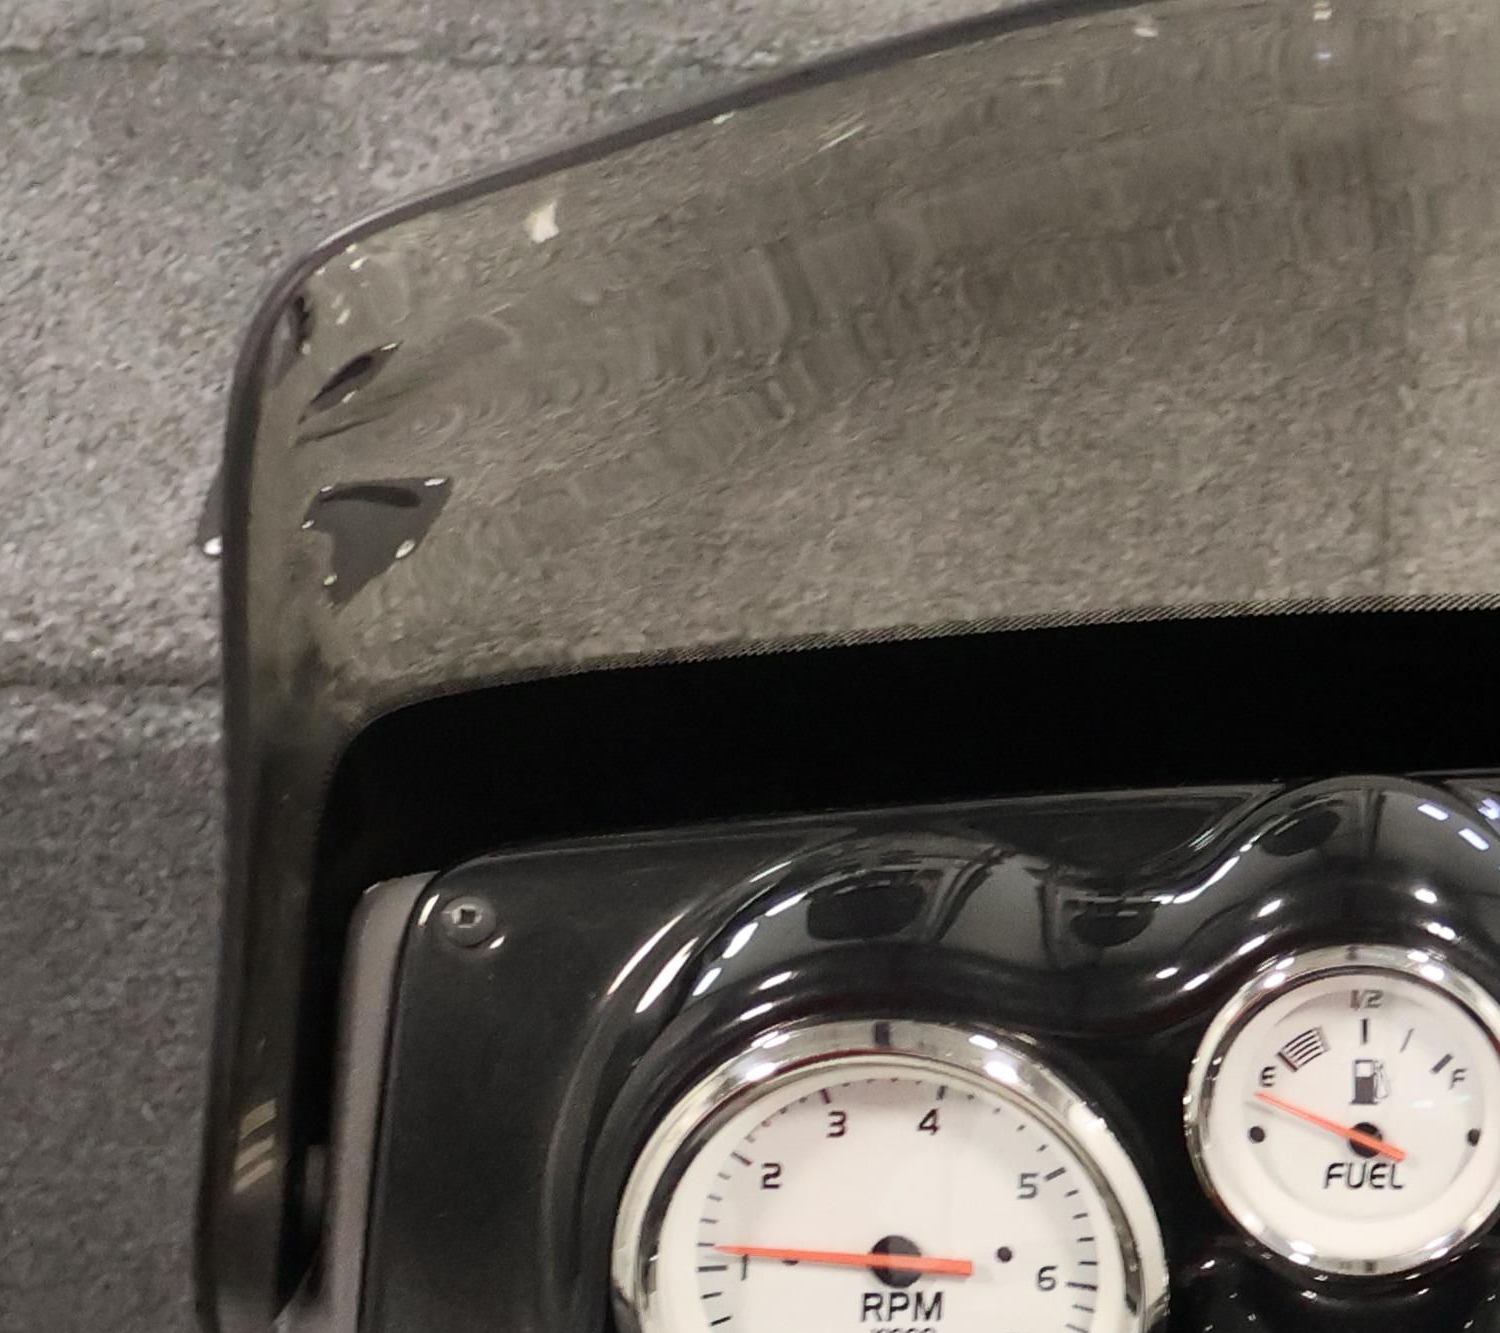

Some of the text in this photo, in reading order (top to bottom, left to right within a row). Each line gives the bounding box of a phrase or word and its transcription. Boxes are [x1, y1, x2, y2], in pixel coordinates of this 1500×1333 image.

[1259, 1065, 1276, 1087] E
[1450, 1067, 1468, 1090] F
[826, 1111, 847, 1139] 3
[917, 1108, 940, 1136] 4
[760, 1164, 782, 1190] 2
[1018, 1174, 1038, 1199] 5
[1323, 1161, 1405, 1190] FUEL
[1038, 1266, 1057, 1291] 6
[860, 1292, 944, 1323] RPM
